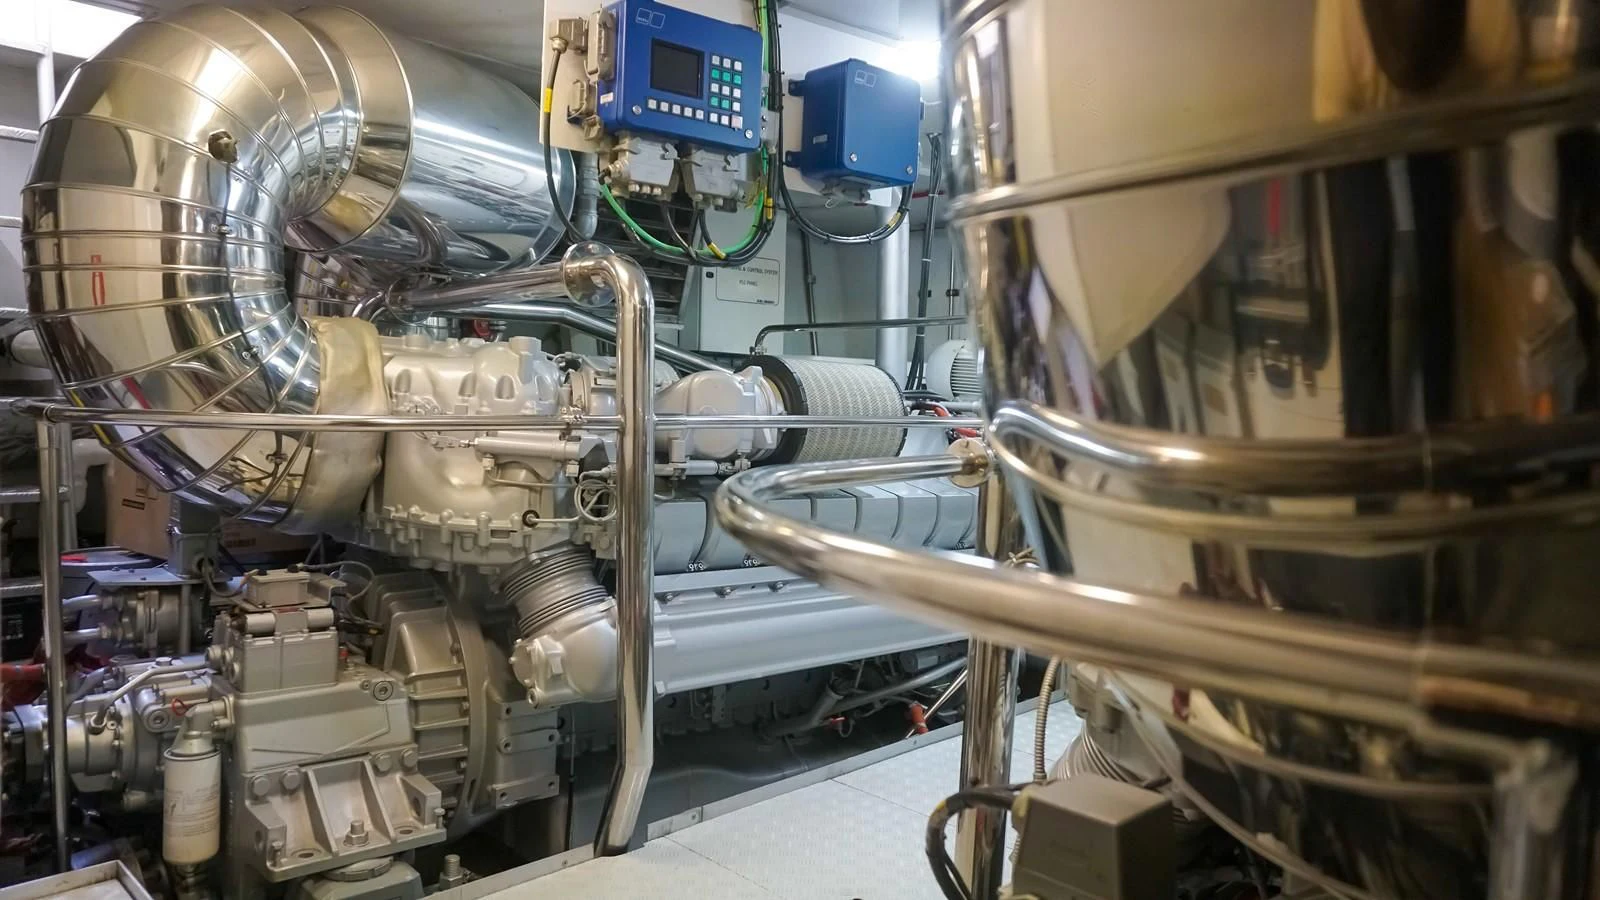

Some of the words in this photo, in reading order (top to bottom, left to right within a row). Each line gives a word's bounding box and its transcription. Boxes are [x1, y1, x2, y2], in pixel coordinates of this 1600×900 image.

[747, 266, 763, 274] CONTROL
[764, 268, 778, 276] SYSTEM
[746, 279, 758, 287] PANEL
